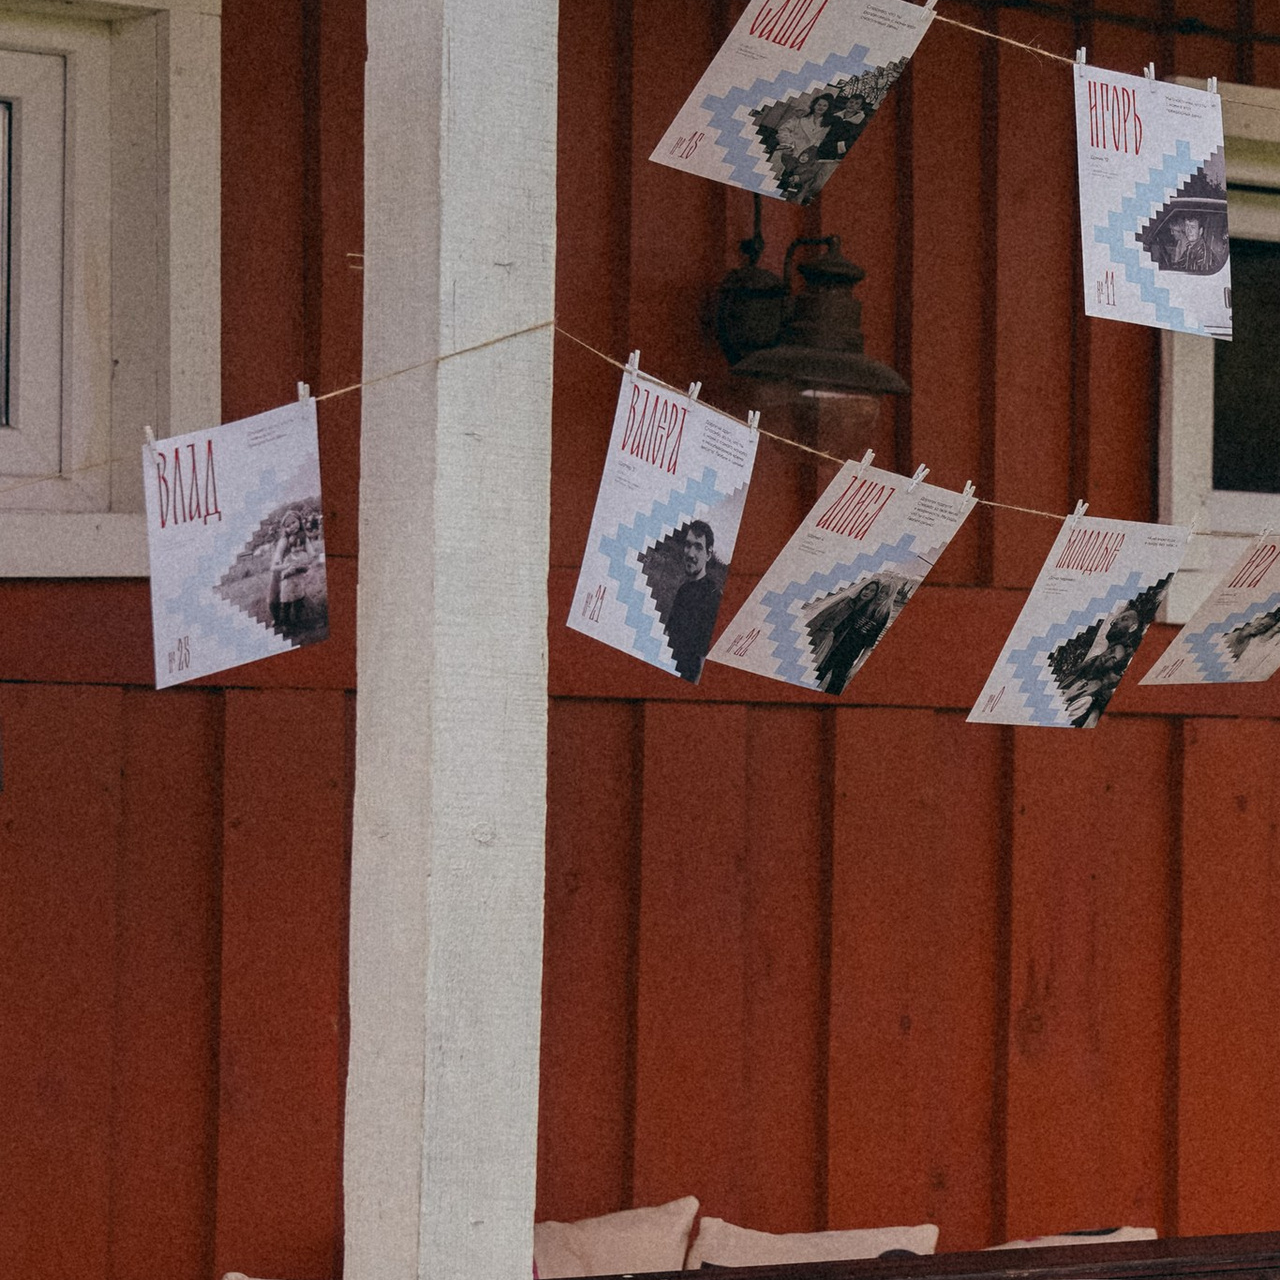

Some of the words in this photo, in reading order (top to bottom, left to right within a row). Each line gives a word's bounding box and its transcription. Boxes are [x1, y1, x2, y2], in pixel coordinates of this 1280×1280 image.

[1088, 81, 1142, 155] ИГОРЬ
[622, 384, 689, 475] ВАЛЕРА
[157, 440, 221, 528] ВЛАД
[816, 476, 895, 540] АЛИСА
[1056, 529, 1125, 575] МОЛОДЫЕ
